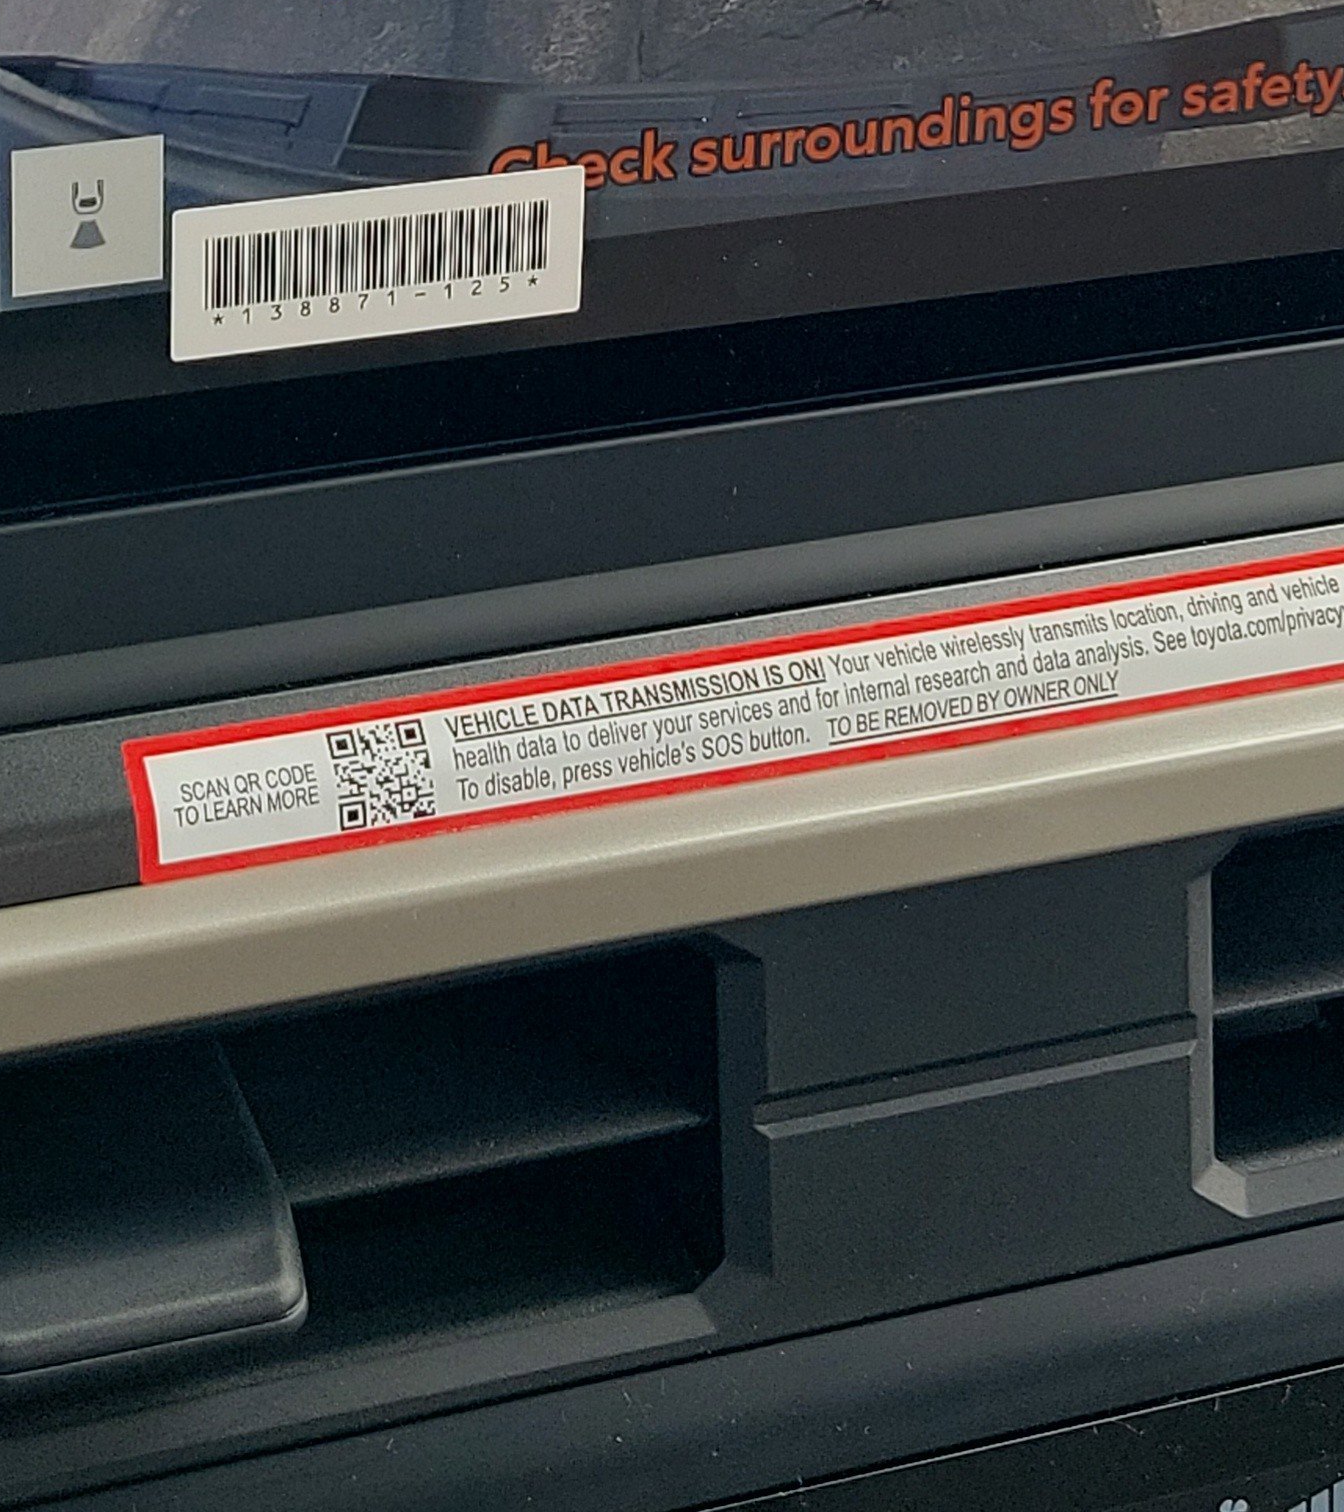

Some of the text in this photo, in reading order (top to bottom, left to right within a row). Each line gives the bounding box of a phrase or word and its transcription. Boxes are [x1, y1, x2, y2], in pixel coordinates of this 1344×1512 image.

[691, 94, 1075, 175] surroundings
[1089, 78, 1168, 130] for
[445, 574, 1340, 738] VEHICLE DATA TRANSMISSION IS ON! Your vehicle wirelessly transmits location, driving and vehicle
[453, 740, 512, 771] health
[516, 733, 557, 760] data
[564, 729, 581, 752] to
[588, 718, 648, 749] deliver
[653, 711, 693, 739] your
[698, 699, 773, 731] services
[778, 688, 811, 717] and
[817, 688, 839, 711] for
[846, 672, 910, 706] internal
[915, 661, 990, 695] research
[996, 654, 1027, 681] and
[1033, 648, 1071, 674] data
[1075, 635, 1149, 668] analysis.
[1152, 629, 1187, 654] See
[826, 670, 1119, 739] TO BE REMOVED BY OWNER ONLY
[180, 763, 317, 803] SCAN QR CODE
[456, 725, 811, 802] To disable, press vehicle's SOS button.
[174, 785, 321, 828] TO LEARN MORE
